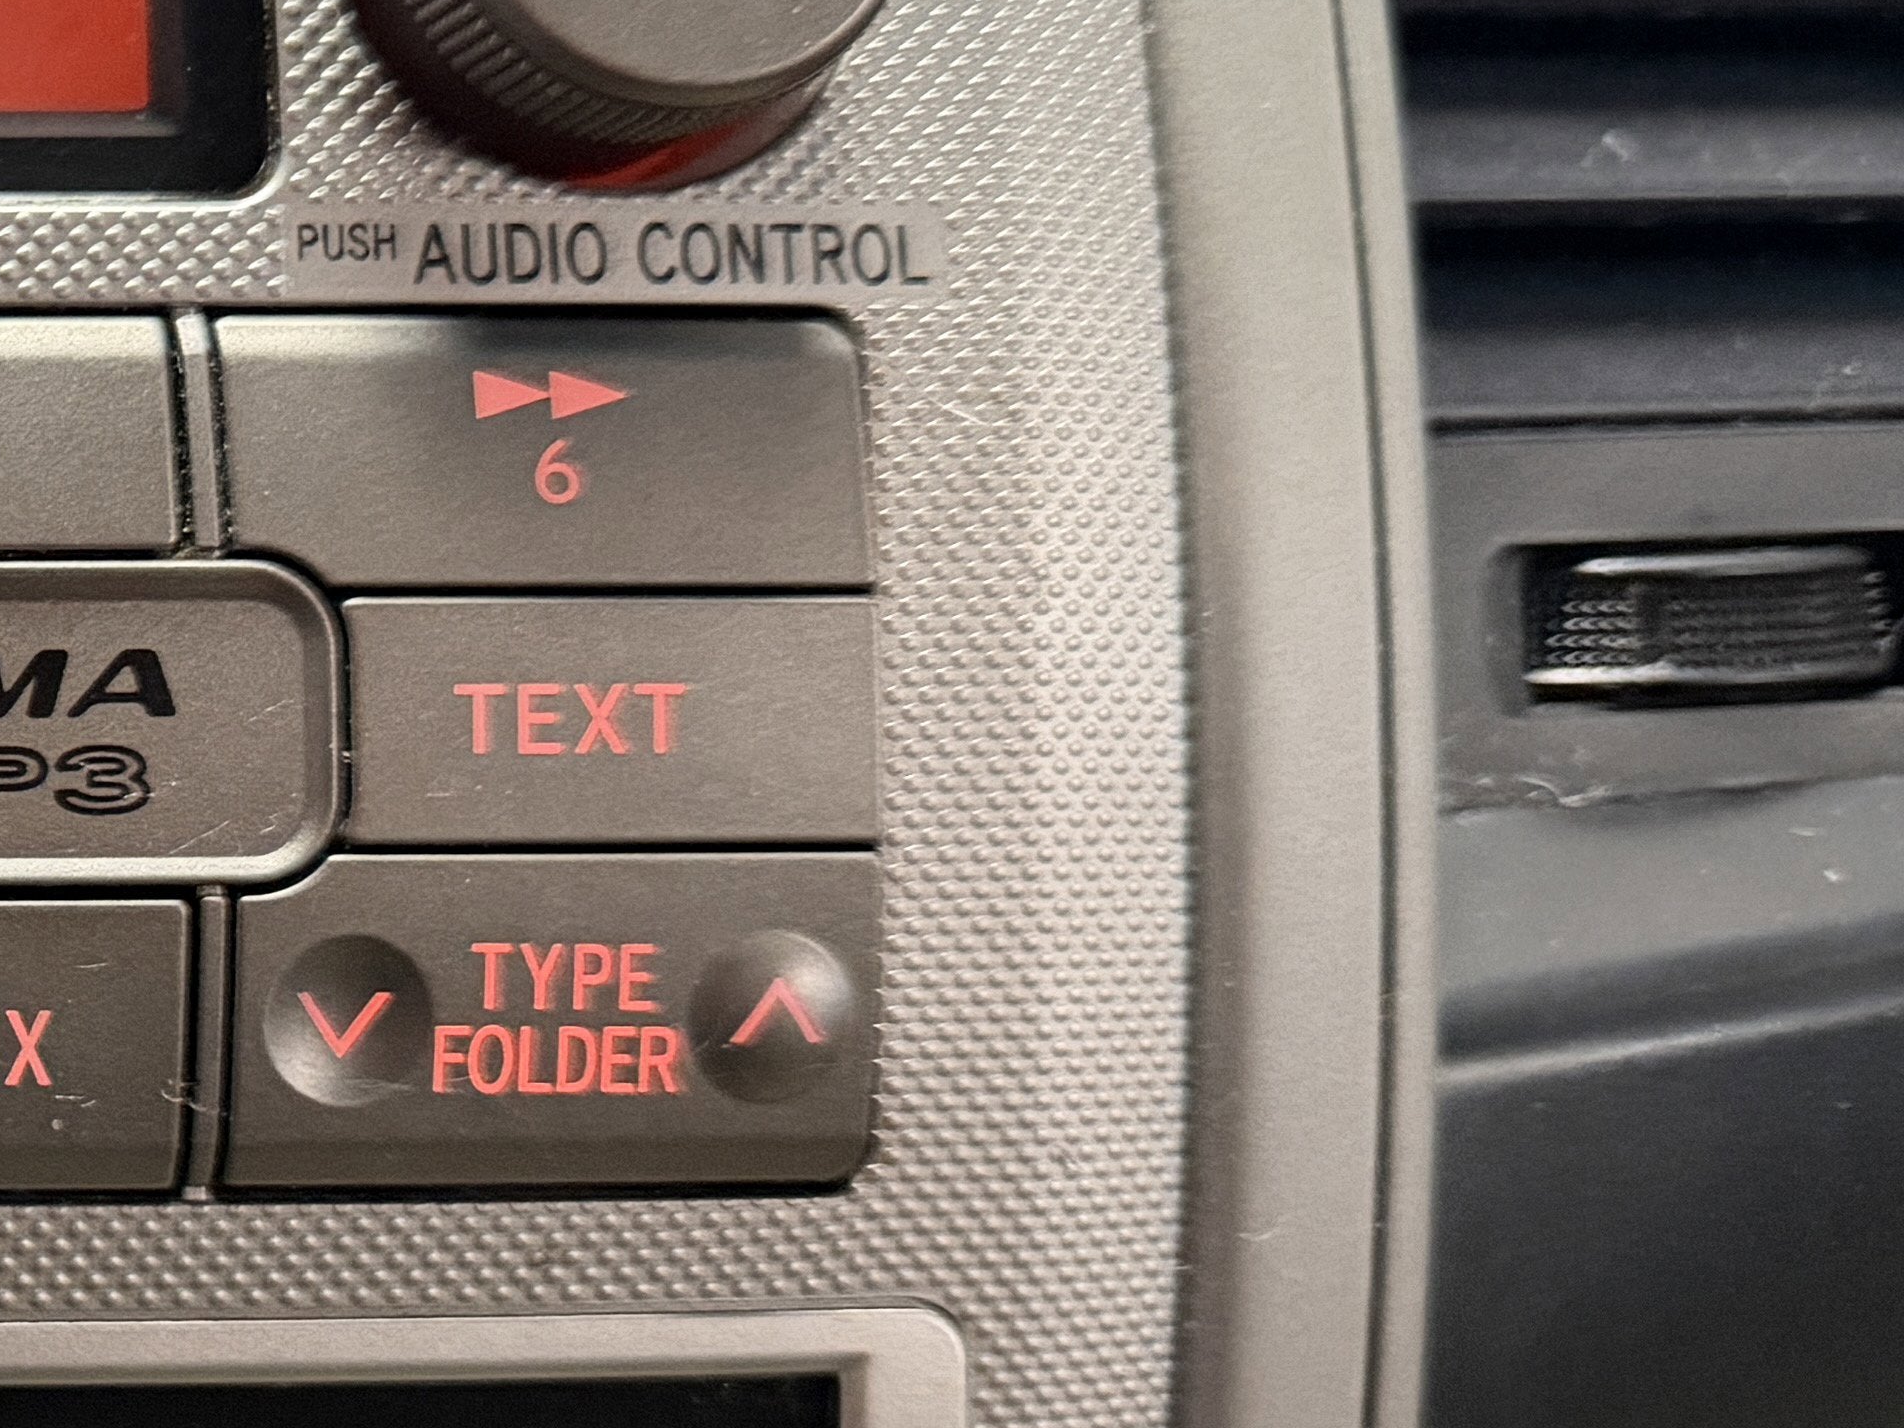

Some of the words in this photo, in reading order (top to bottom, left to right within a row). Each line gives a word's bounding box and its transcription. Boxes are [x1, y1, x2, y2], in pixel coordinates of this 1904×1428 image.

[297, 222, 395, 263] PUSH
[413, 221, 608, 285] AUDIO
[637, 222, 929, 287] CONTROL
[534, 439, 583, 504] 6
[452, 682, 688, 755] TEXT
[470, 942, 658, 1012] TYPE
[431, 1024, 682, 1095] FOLDER
